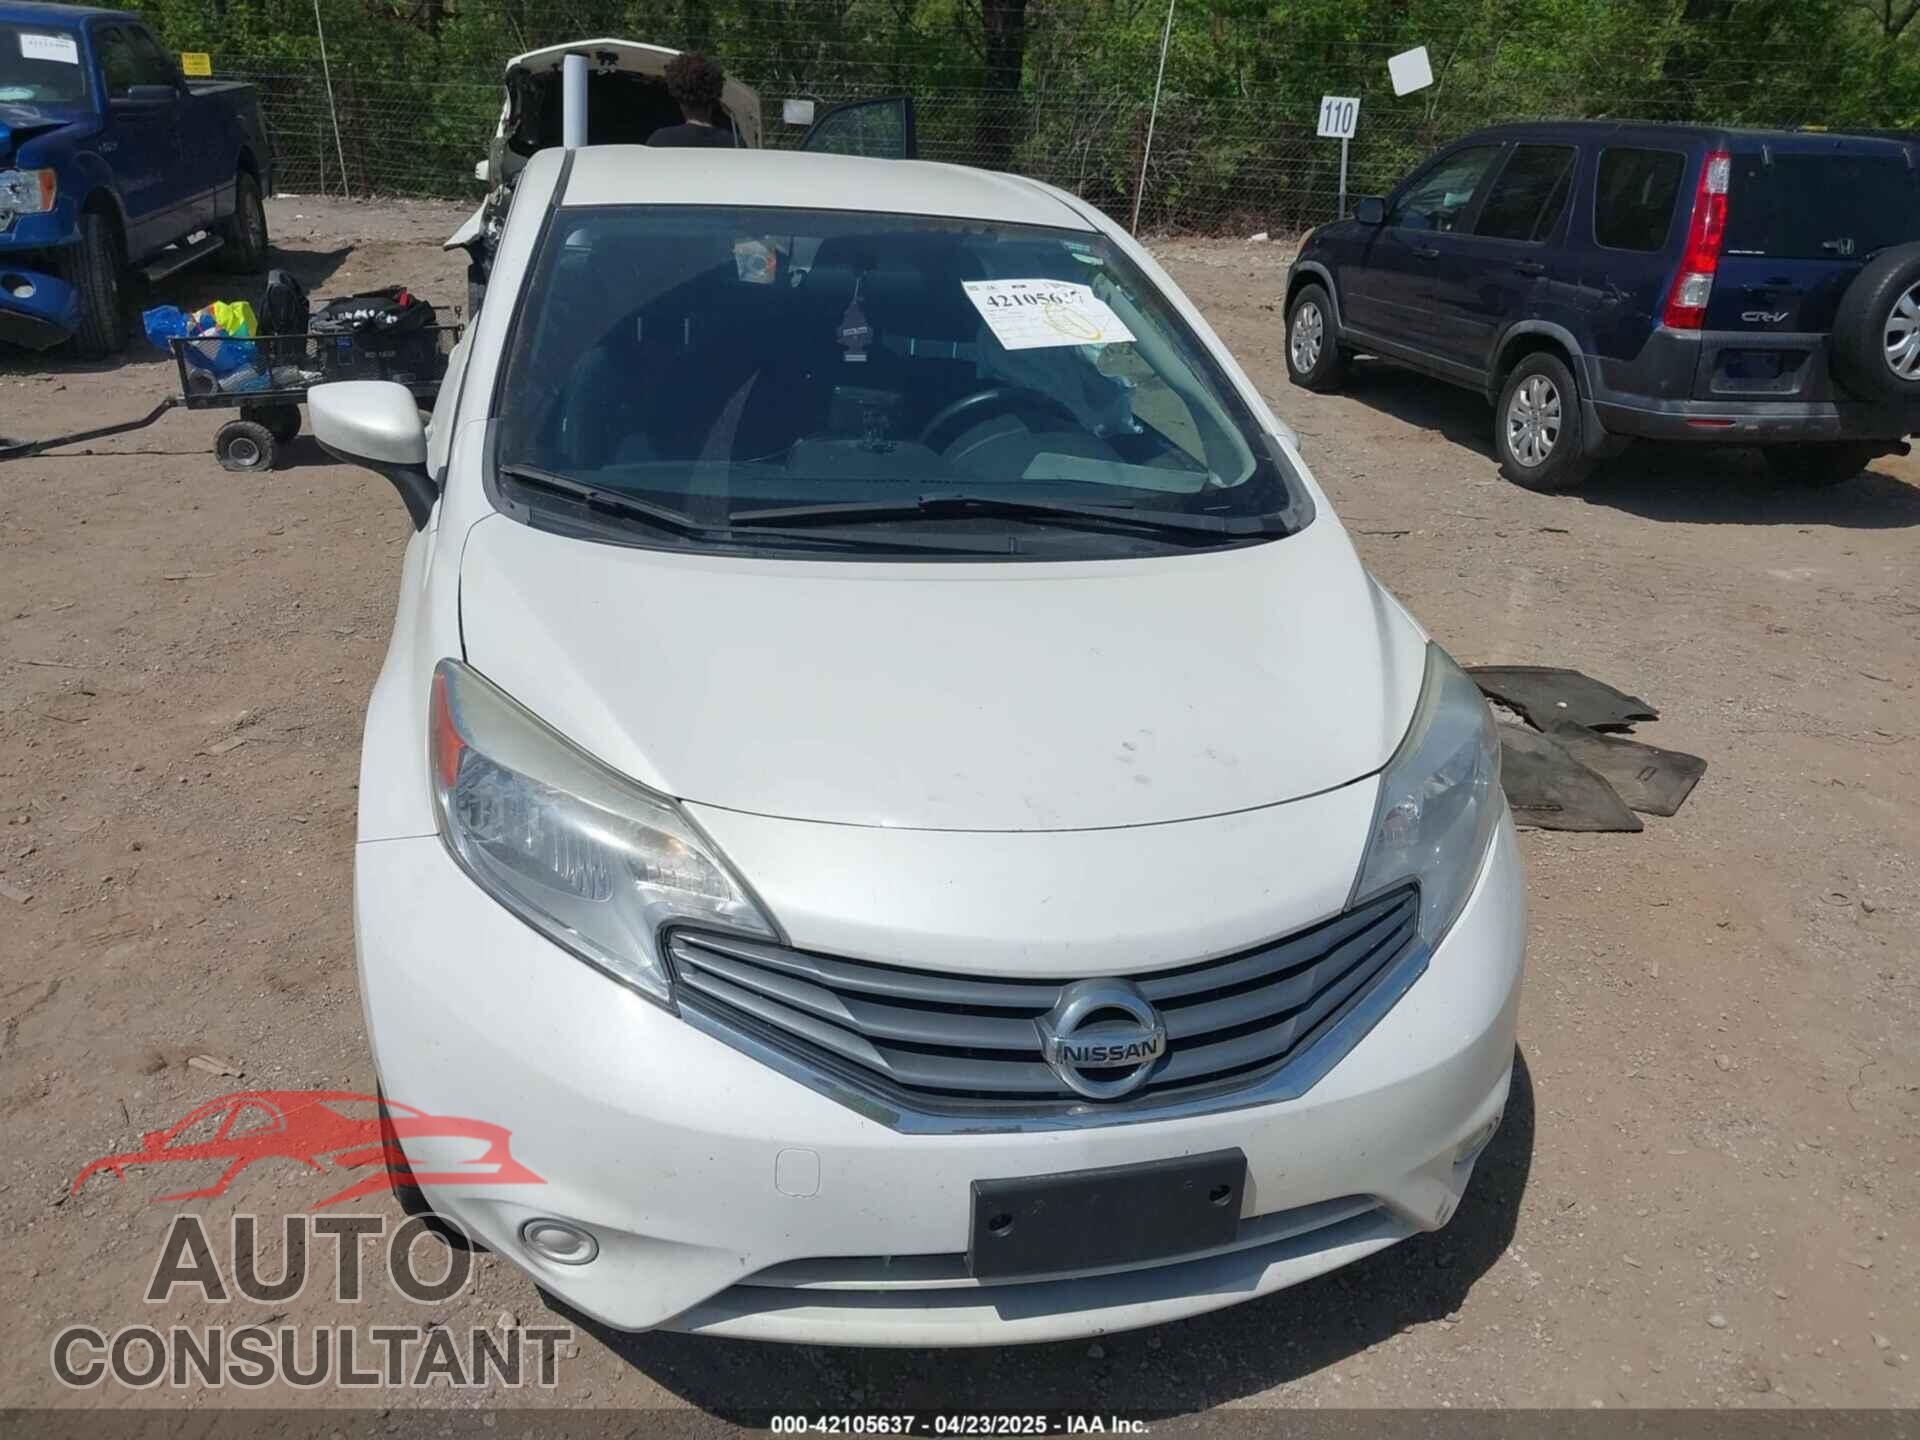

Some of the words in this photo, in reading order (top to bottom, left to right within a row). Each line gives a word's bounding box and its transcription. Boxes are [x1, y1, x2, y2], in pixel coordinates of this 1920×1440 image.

[1325, 101, 1354, 134] 110
[1741, 311, 1790, 323] CR-V
[1063, 1039, 1157, 1062] NISSAN
